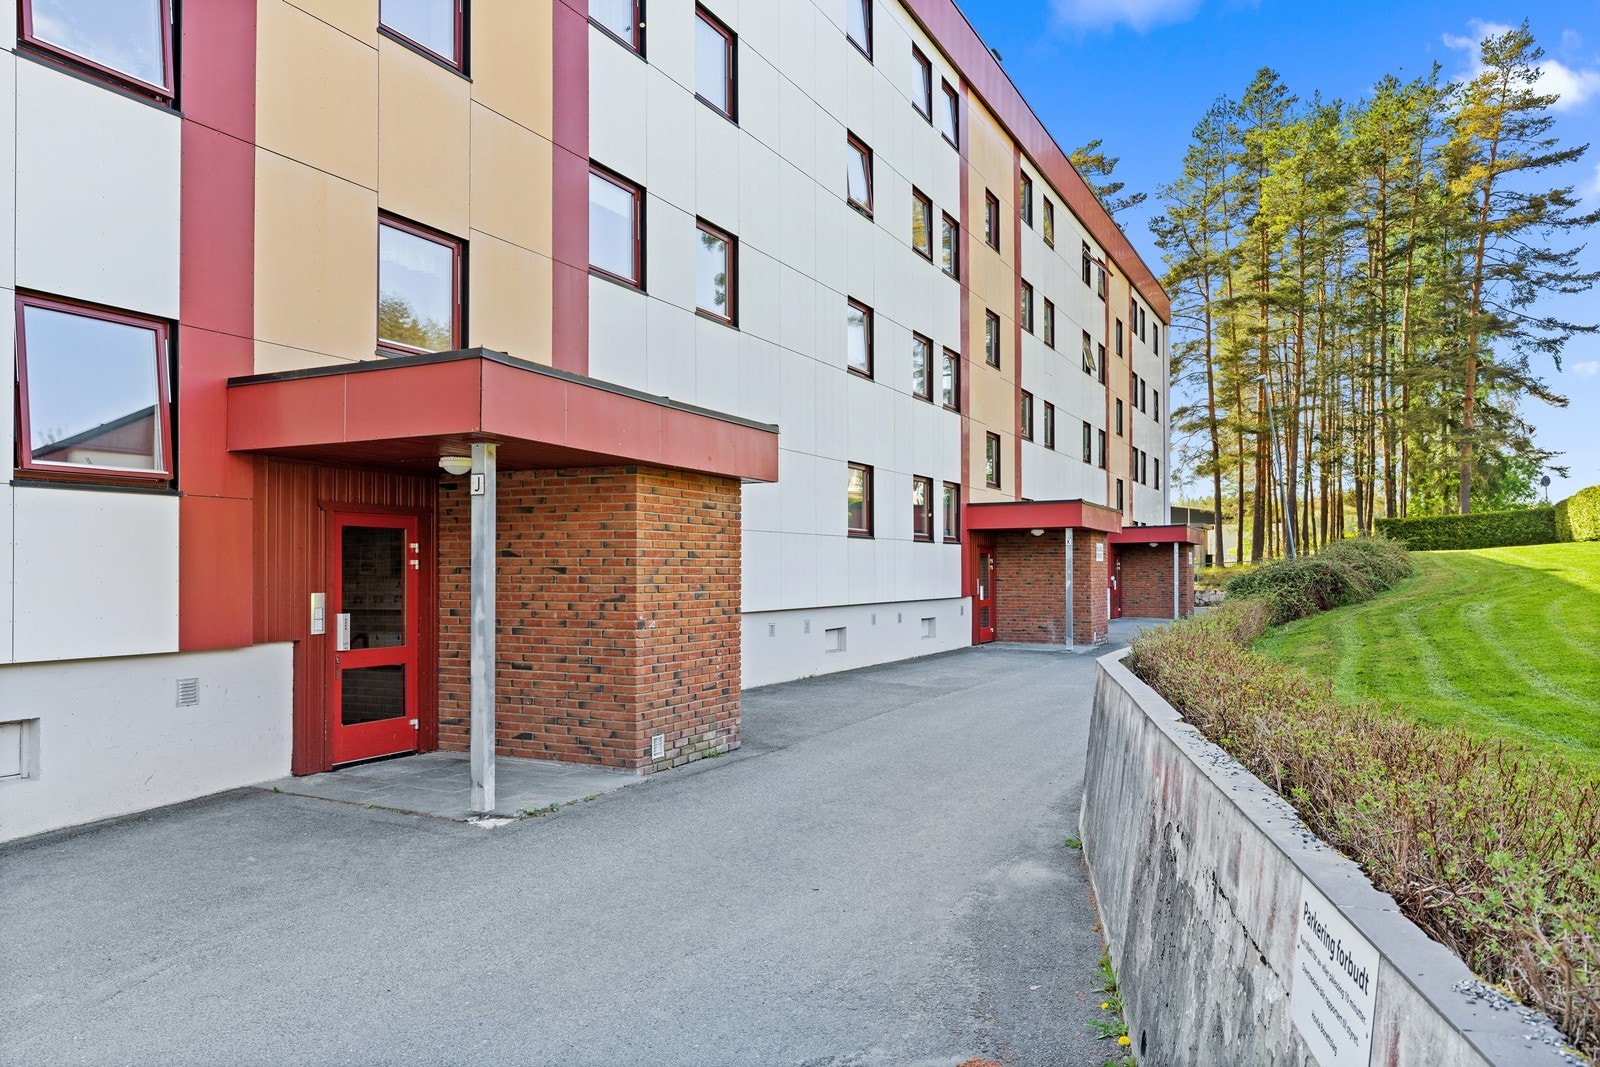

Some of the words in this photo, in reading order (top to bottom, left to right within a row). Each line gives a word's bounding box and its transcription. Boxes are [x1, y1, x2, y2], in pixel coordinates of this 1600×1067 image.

[474, 477, 480, 492] J
[1303, 901, 1336, 961] Parkering
[1336, 939, 1369, 996] forbudt
[1302, 963, 1320, 993] Overtredelse
[1325, 996, 1343, 1025] rapportert
